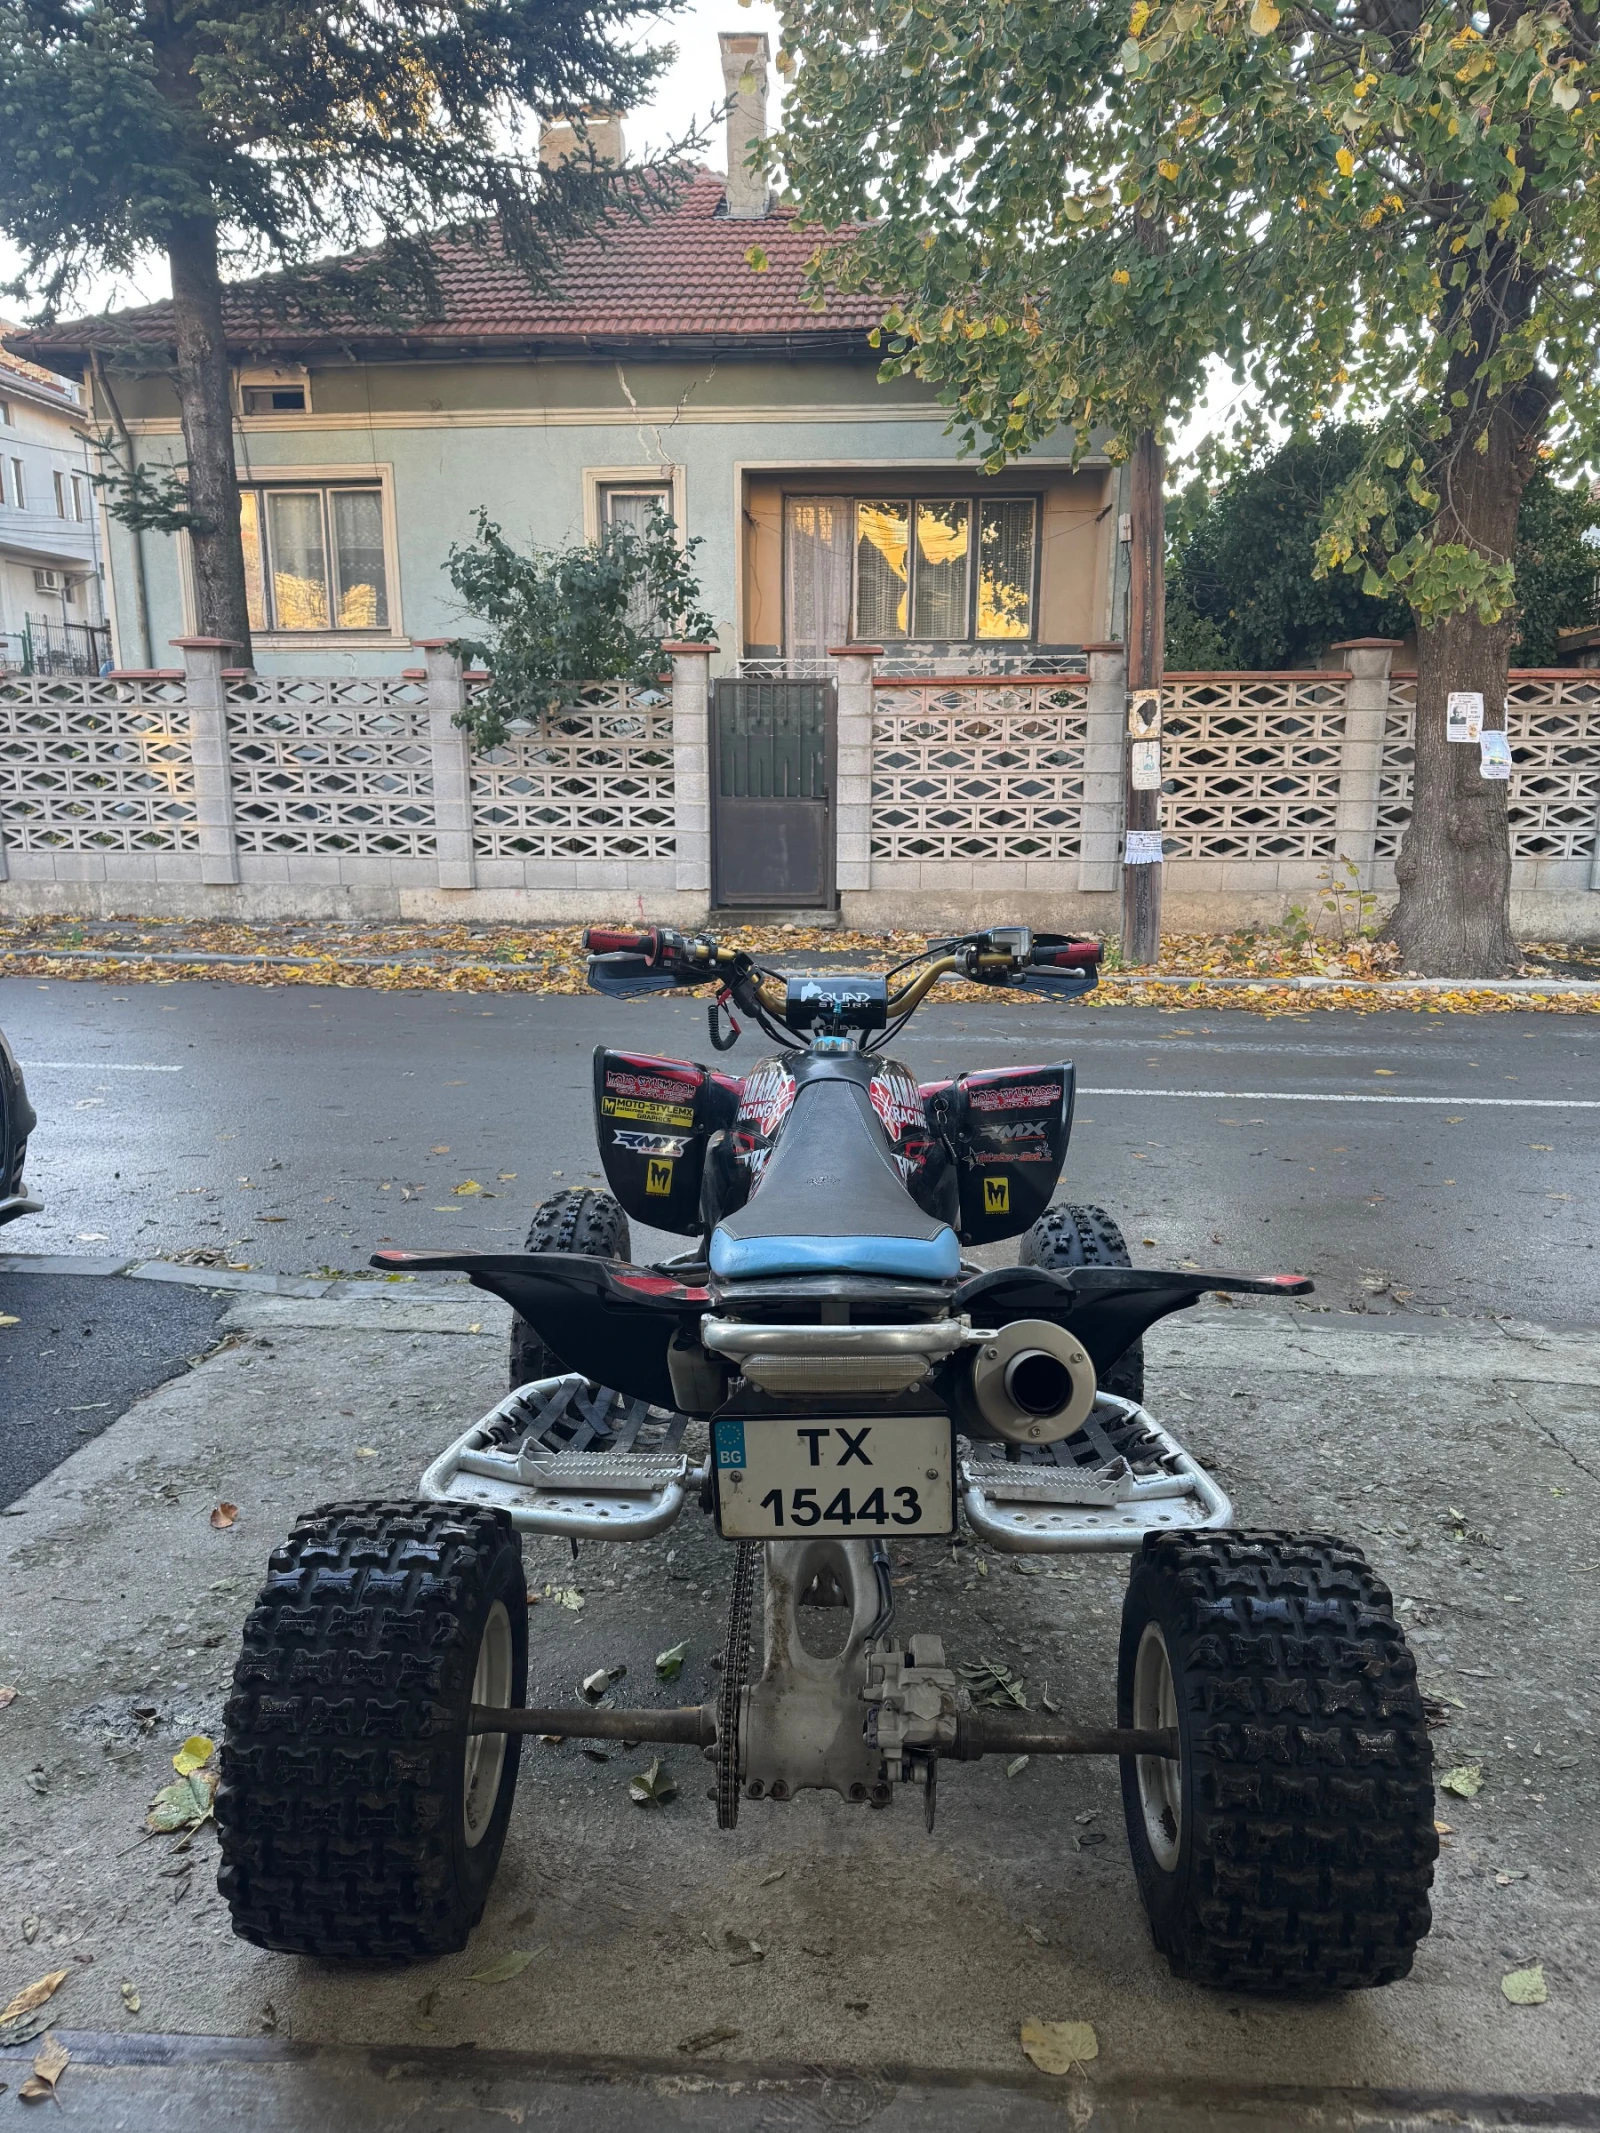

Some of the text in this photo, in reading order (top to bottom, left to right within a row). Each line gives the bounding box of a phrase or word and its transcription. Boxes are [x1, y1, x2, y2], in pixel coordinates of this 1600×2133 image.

[818, 992, 871, 1003] QUAD
[616, 1099, 693, 1116] MOTO-STYLEMX
[636, 1113, 672, 1123] GRAPHICS
[979, 1121, 1048, 1140] RMX
[617, 1132, 687, 1151] RMX
[651, 1162, 671, 1191] M
[986, 1180, 1006, 1208] M
[796, 1427, 874, 1467] TX
[720, 1450, 742, 1464] BG
[760, 1486, 922, 1527] 15443
